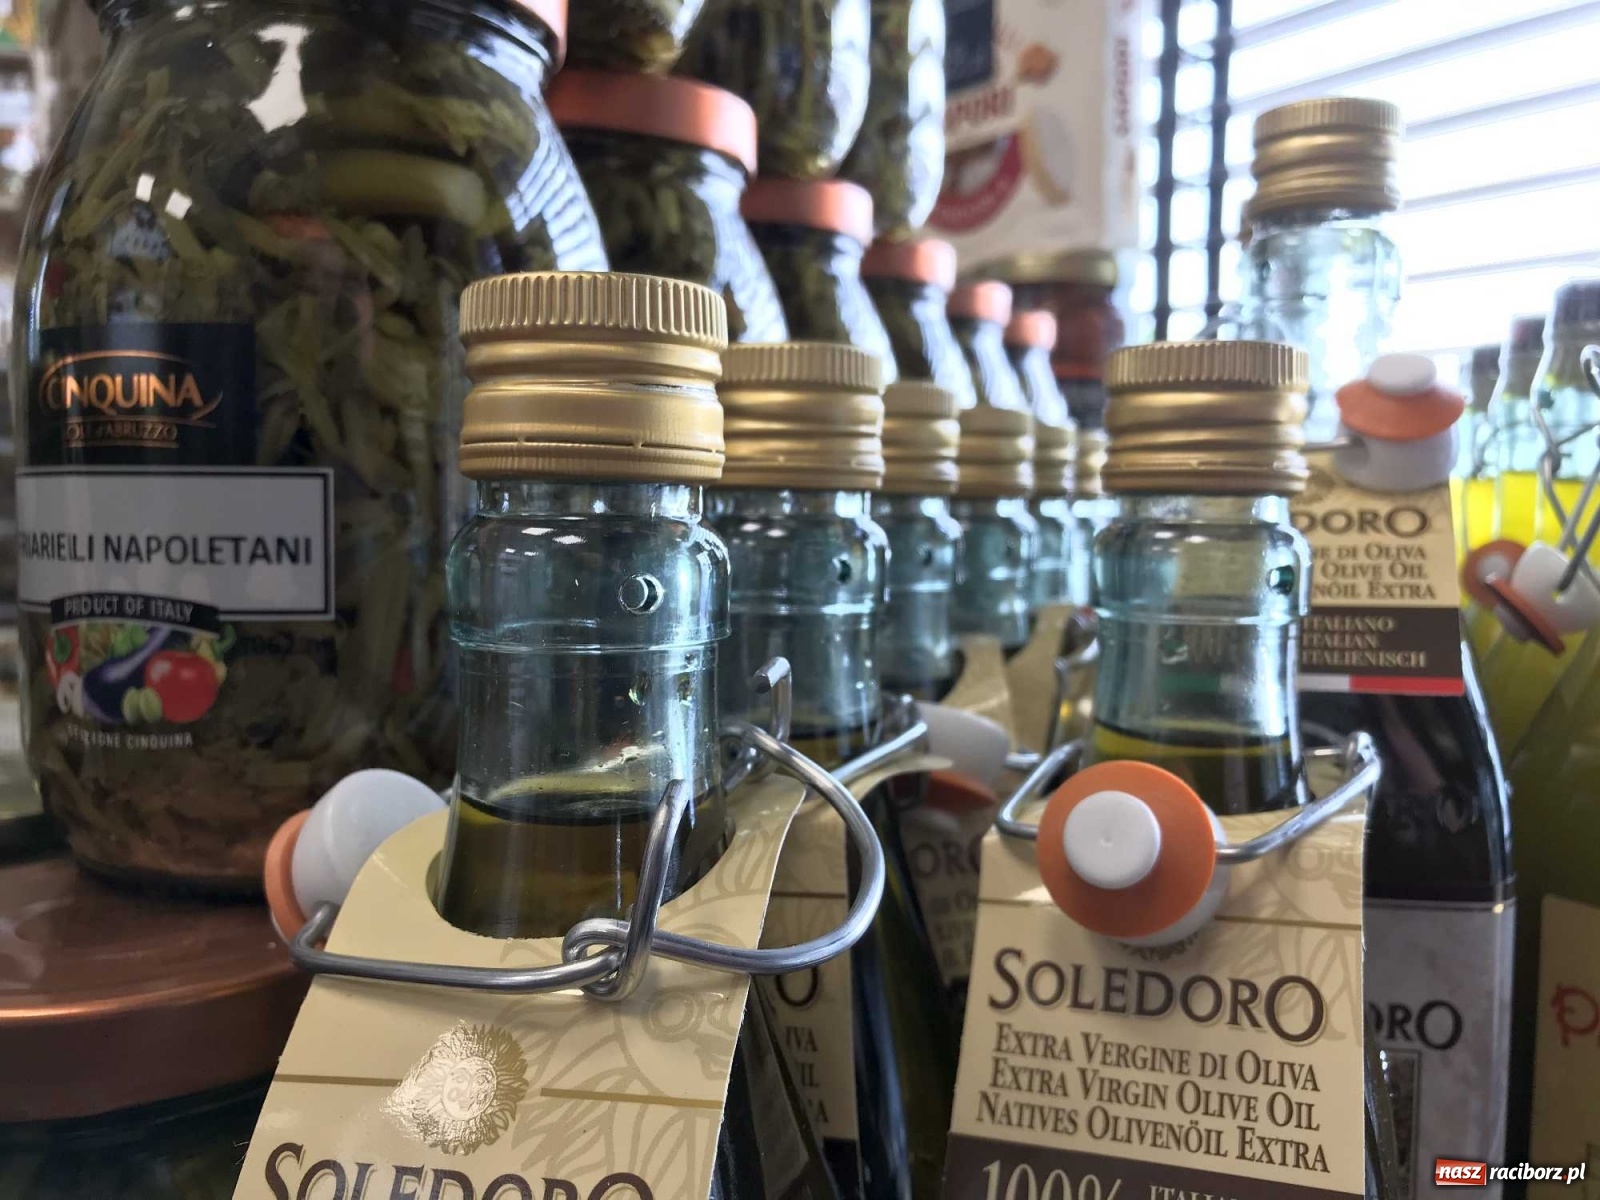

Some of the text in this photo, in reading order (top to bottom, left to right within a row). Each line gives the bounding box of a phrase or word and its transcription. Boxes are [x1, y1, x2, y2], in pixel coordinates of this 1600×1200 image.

[1292, 506, 1428, 538] DORO
[103, 533, 312, 566] NAPOLETANI
[1337, 545, 1357, 561] DI
[1364, 542, 1428, 561] OLIVA
[1321, 560, 1429, 580] OLIVE OIL
[1366, 582, 1437, 600] EXTRA
[124, 595, 145, 616] OF
[150, 599, 194, 623] ITALY
[1302, 615, 1396, 633] ITALIANO
[1302, 632, 1380, 649] ITALIAN
[1302, 650, 1428, 668] ITALIENISCH
[987, 947, 1325, 1043] SOLEDORO
[785, 1025, 818, 1053] IVA
[994, 1021, 1322, 1093] EXTRA VERGINE DI OLIVA
[989, 1056, 1321, 1132] EXTRA VIRGIN OLIVE OIL
[975, 1090, 1332, 1174] NATIVES OLIVENÖIL EXTRA
